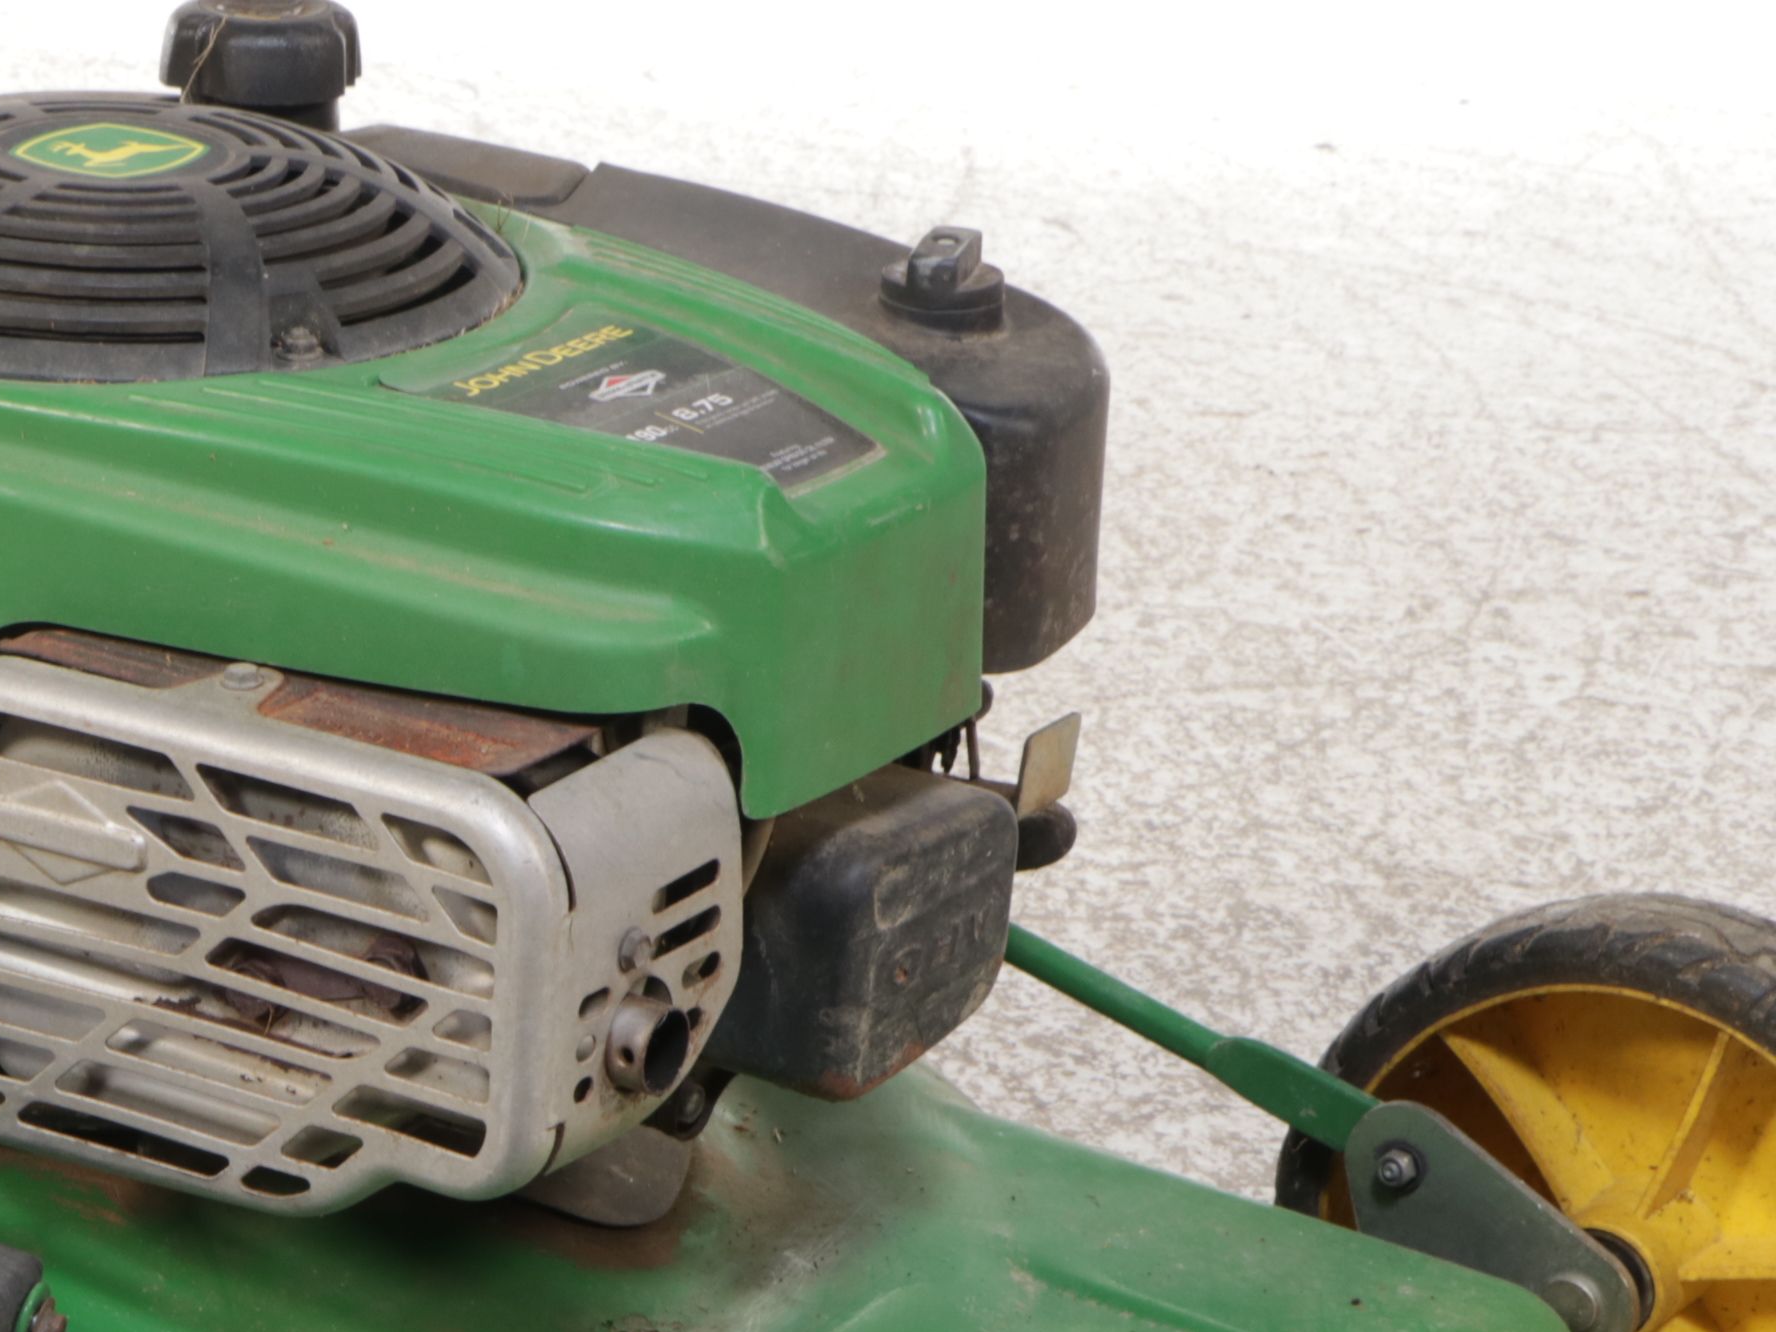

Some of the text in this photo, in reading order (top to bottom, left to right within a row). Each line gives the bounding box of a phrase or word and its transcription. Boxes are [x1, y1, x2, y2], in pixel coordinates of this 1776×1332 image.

[453, 360, 542, 397] JOHN
[522, 324, 634, 366] DEERE
[670, 392, 734, 421] 8.75
